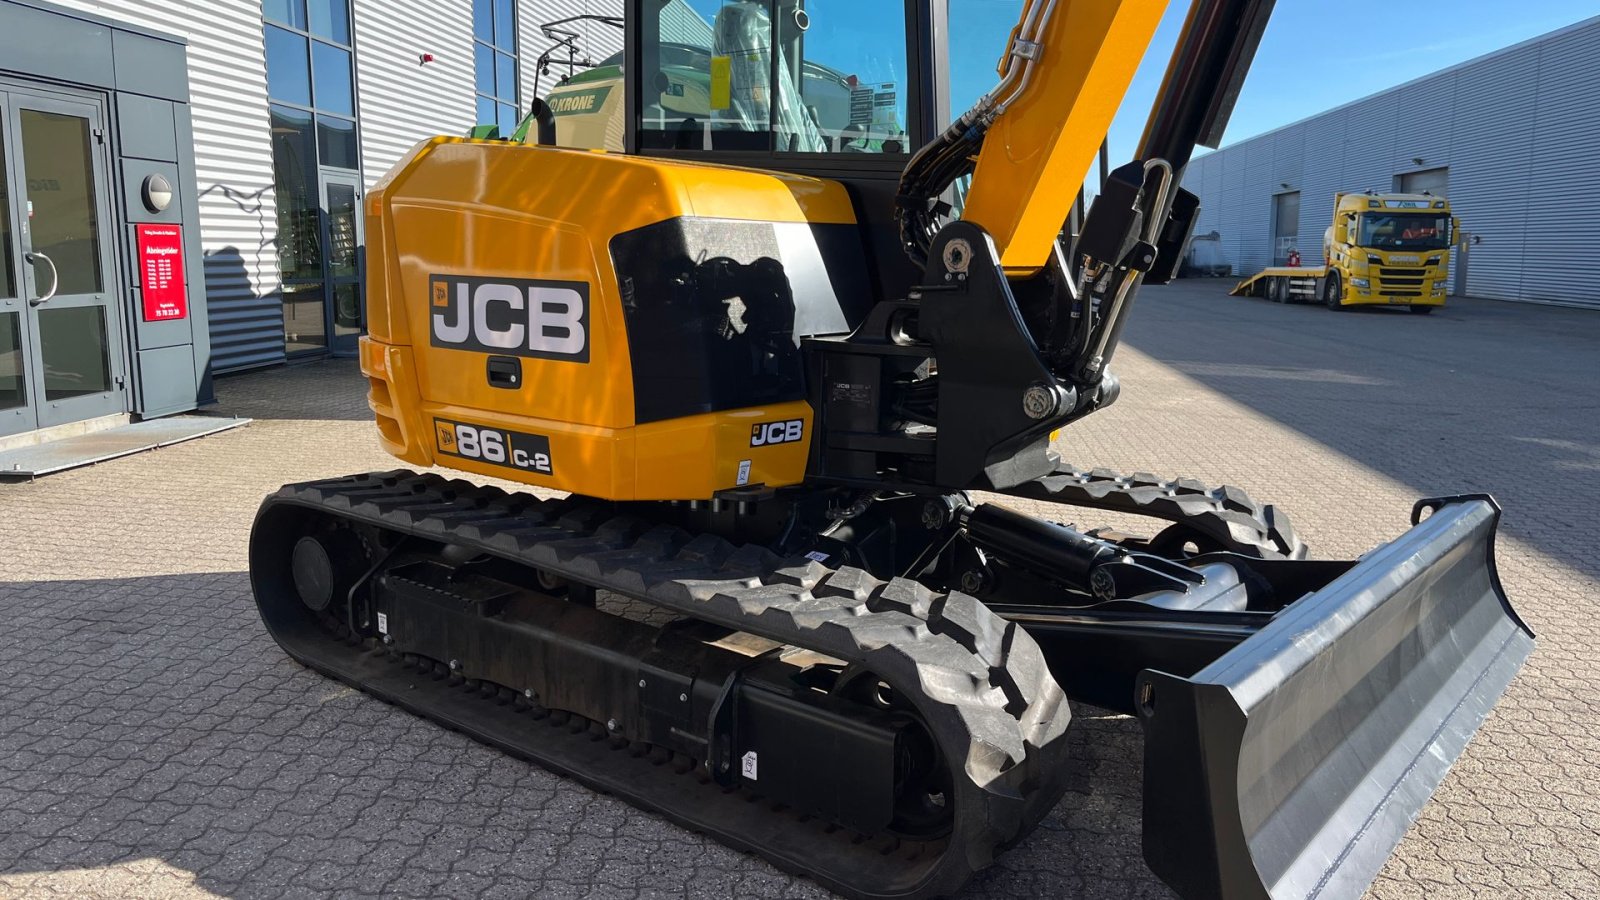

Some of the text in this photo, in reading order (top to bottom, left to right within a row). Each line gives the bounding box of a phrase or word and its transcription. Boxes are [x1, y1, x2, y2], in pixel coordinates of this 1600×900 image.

[556, 94, 596, 112] KRONE
[433, 282, 585, 354] JCB
[455, 424, 551, 472] 86 C-2
[751, 420, 803, 446] JCB
